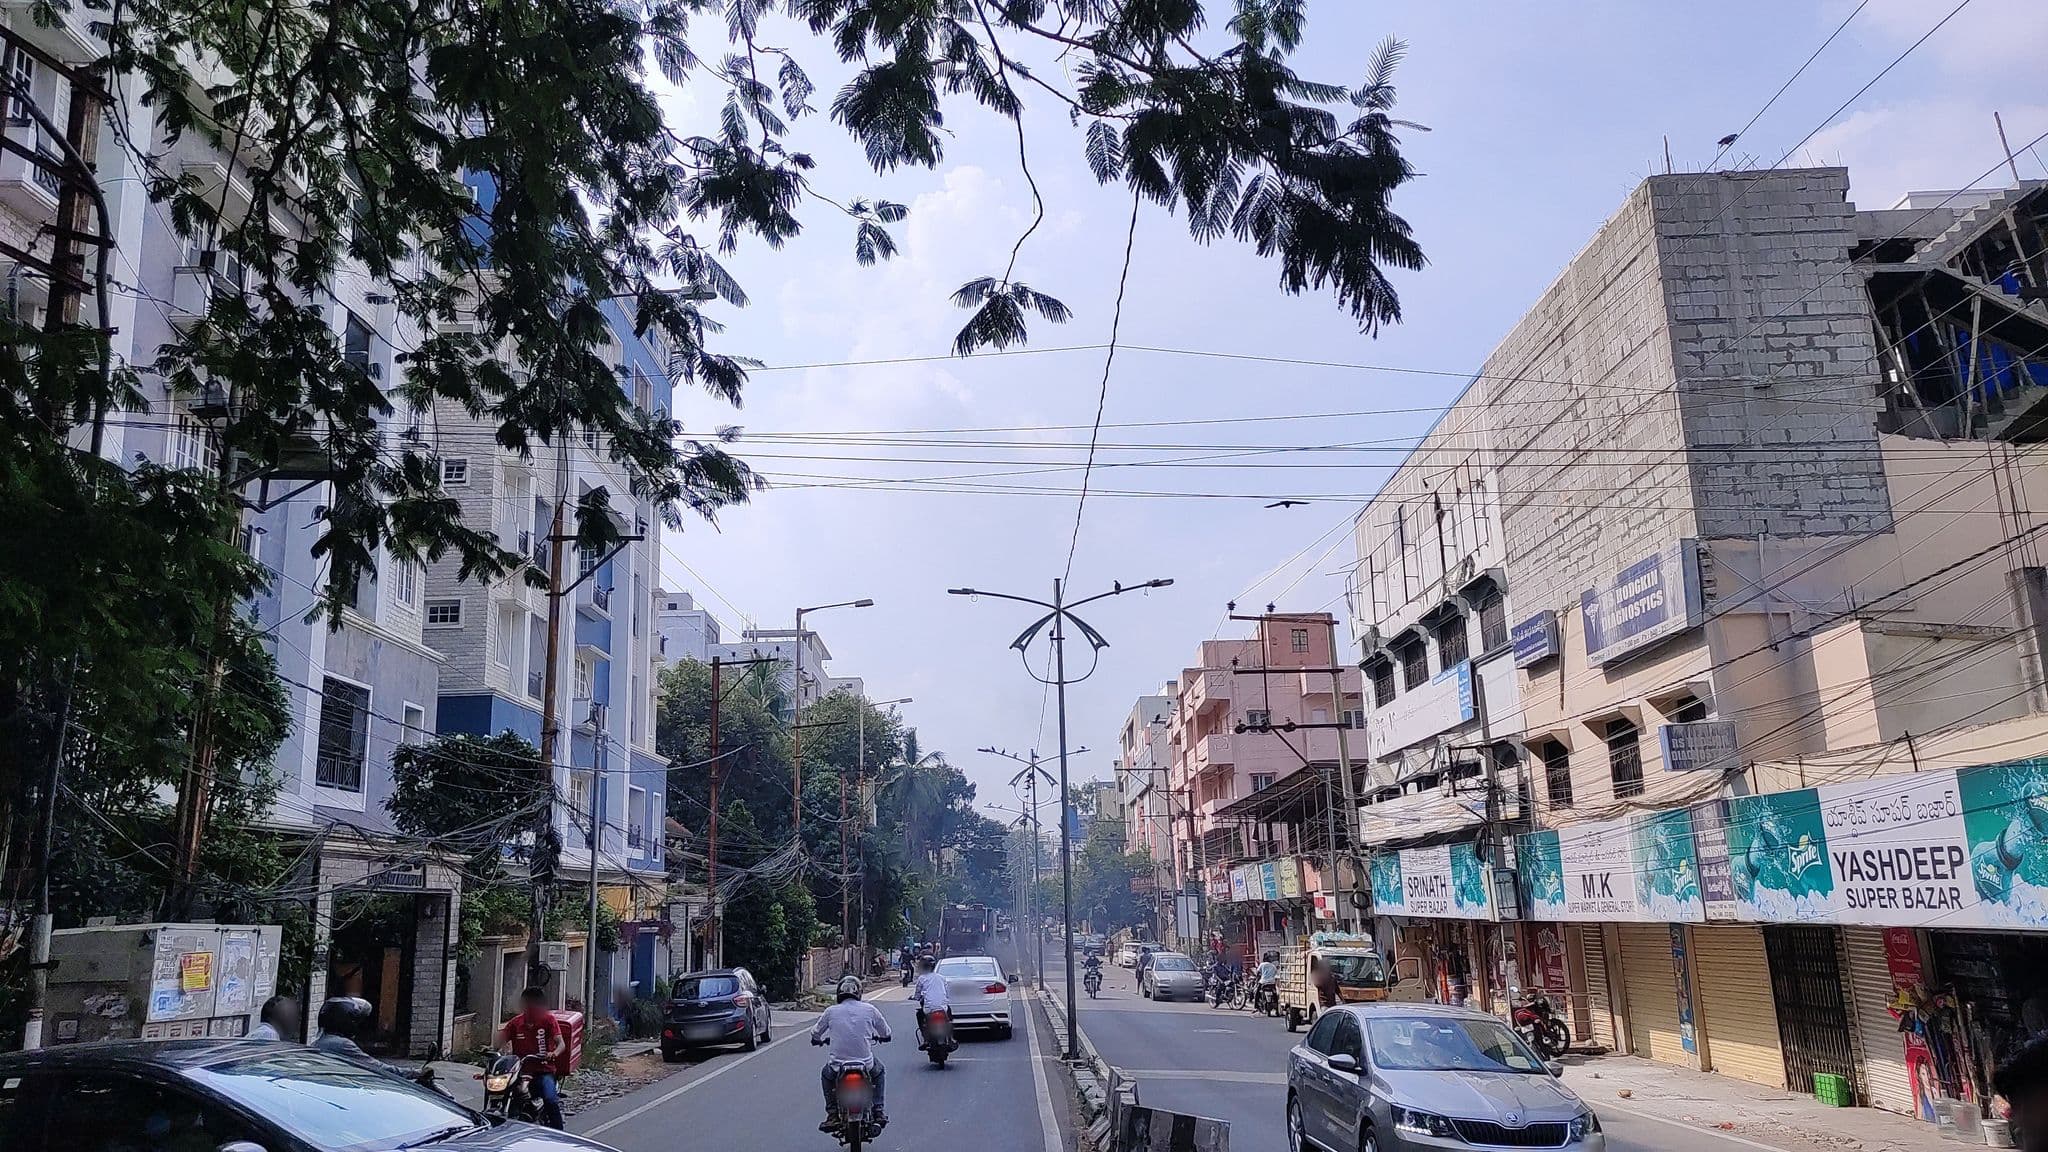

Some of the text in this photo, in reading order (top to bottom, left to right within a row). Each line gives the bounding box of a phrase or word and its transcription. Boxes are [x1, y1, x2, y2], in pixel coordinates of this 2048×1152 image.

[1602, 589, 1664, 634] DIAGNOSTICS
[1870, 795, 1911, 823] సూపర్
[1917, 790, 1956, 817] బజార్
[1791, 843, 1817, 874] Sprite
[1833, 846, 1965, 882] YASHDEEP
[1408, 874, 1447, 899] SRINATH
[1582, 872, 1613, 899] M.K
[1978, 862, 2001, 884] Sprite
[1410, 900, 1448, 914] SUPER BAZAR
[1846, 887, 1963, 909] SUPER BAZAR
